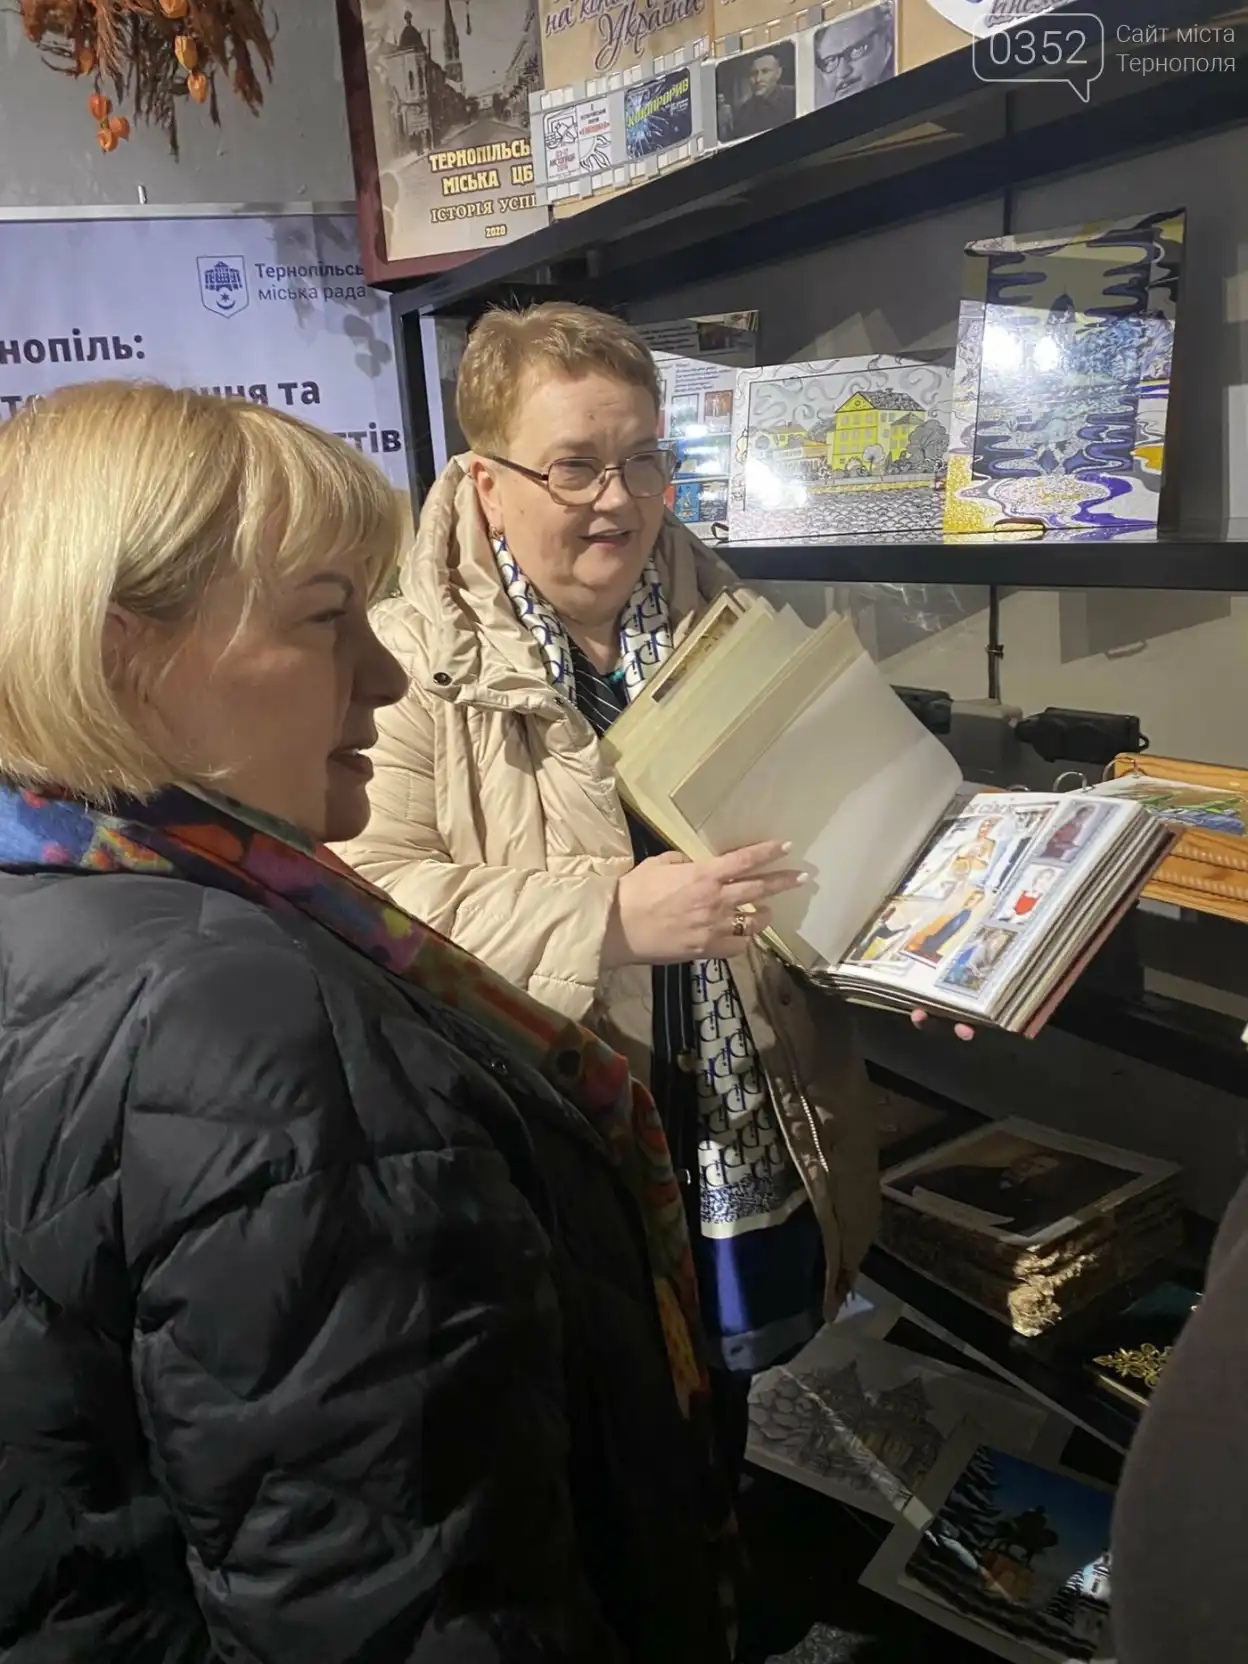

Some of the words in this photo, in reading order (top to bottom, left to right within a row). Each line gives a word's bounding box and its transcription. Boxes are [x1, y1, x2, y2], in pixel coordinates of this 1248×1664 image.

[428, 138, 532, 172] ТЕРНОПІЛЬСЬ
[442, 169, 501, 196] МІСЬКА
[511, 163, 534, 185] ЦБ
[431, 200, 494, 223] ІСТОРІЯ
[484, 225, 507, 238] 2020
[258, 284, 318, 300] міська
[323, 286, 367, 302] рада
[278, 381, 321, 406] та
